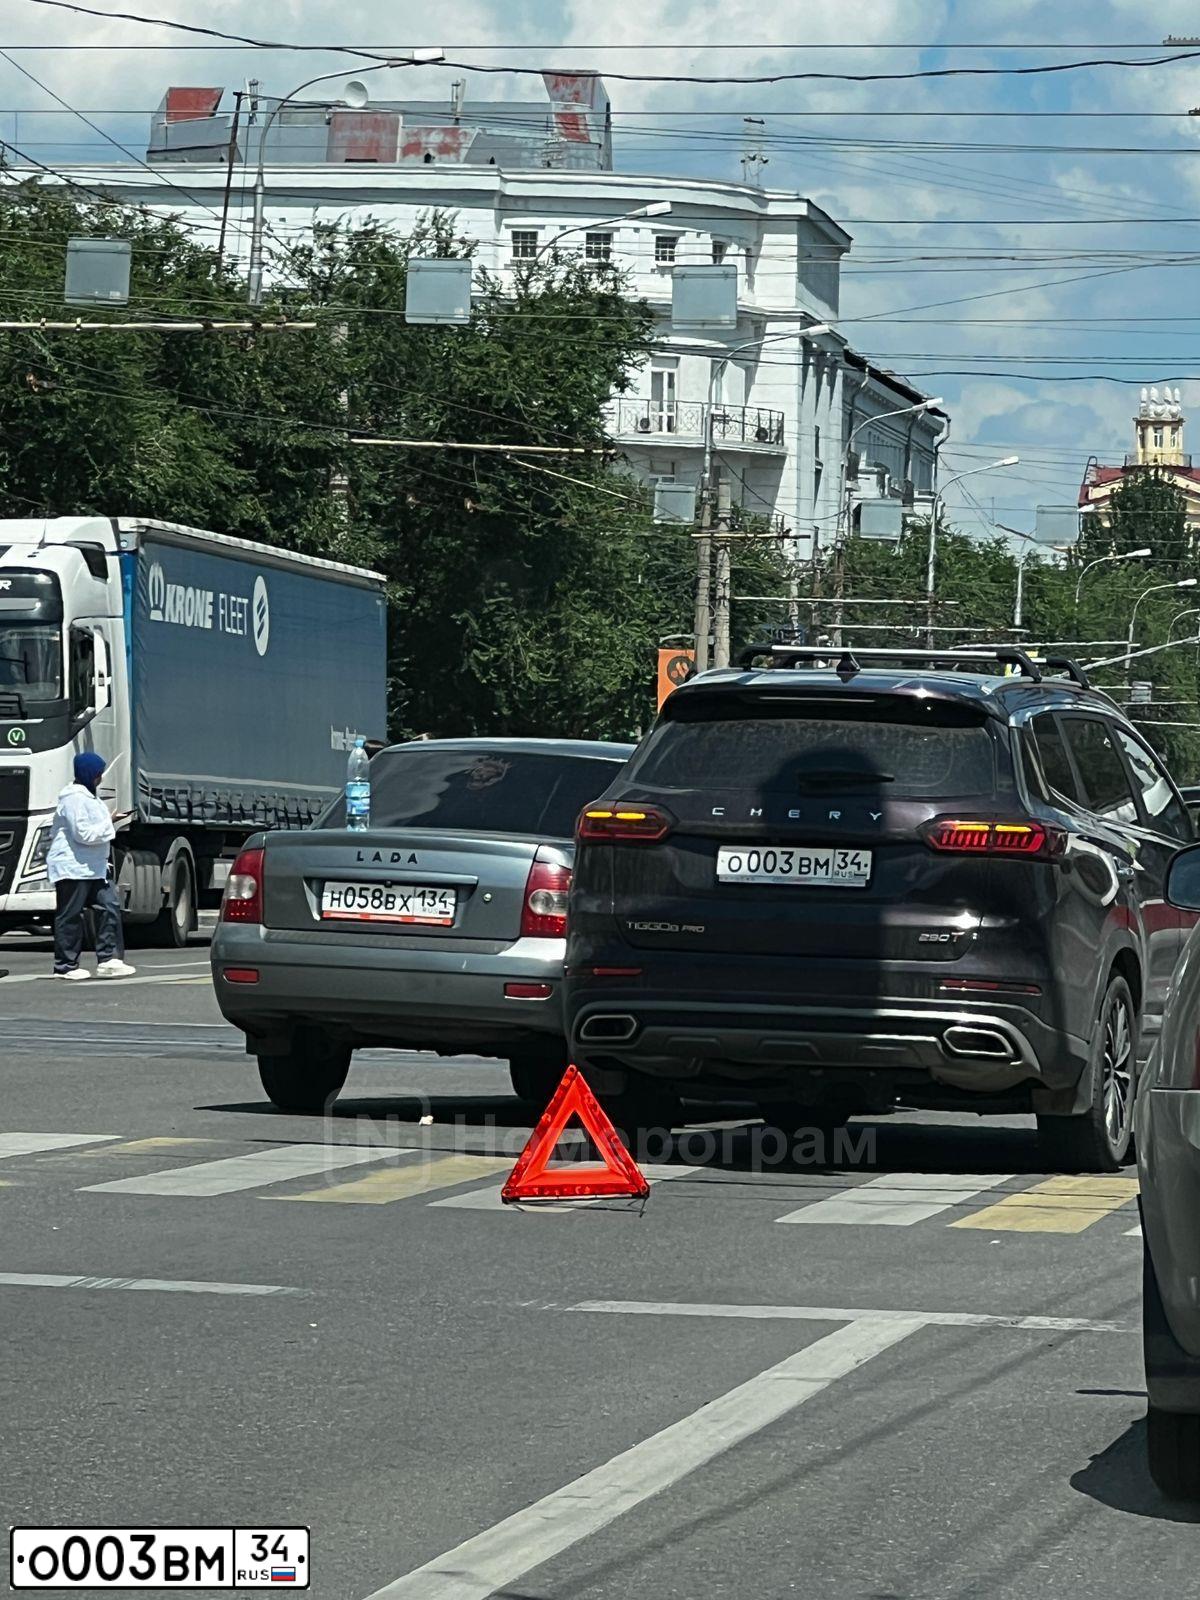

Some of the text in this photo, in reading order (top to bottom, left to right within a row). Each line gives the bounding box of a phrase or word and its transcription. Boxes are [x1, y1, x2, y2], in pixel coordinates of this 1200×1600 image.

[165, 584, 249, 636] KRONE FLEET
[711, 807, 883, 821] CHERY
[356, 851, 418, 864] LADA
[836, 852, 862, 871] 34
[417, 889, 448, 909] 134
